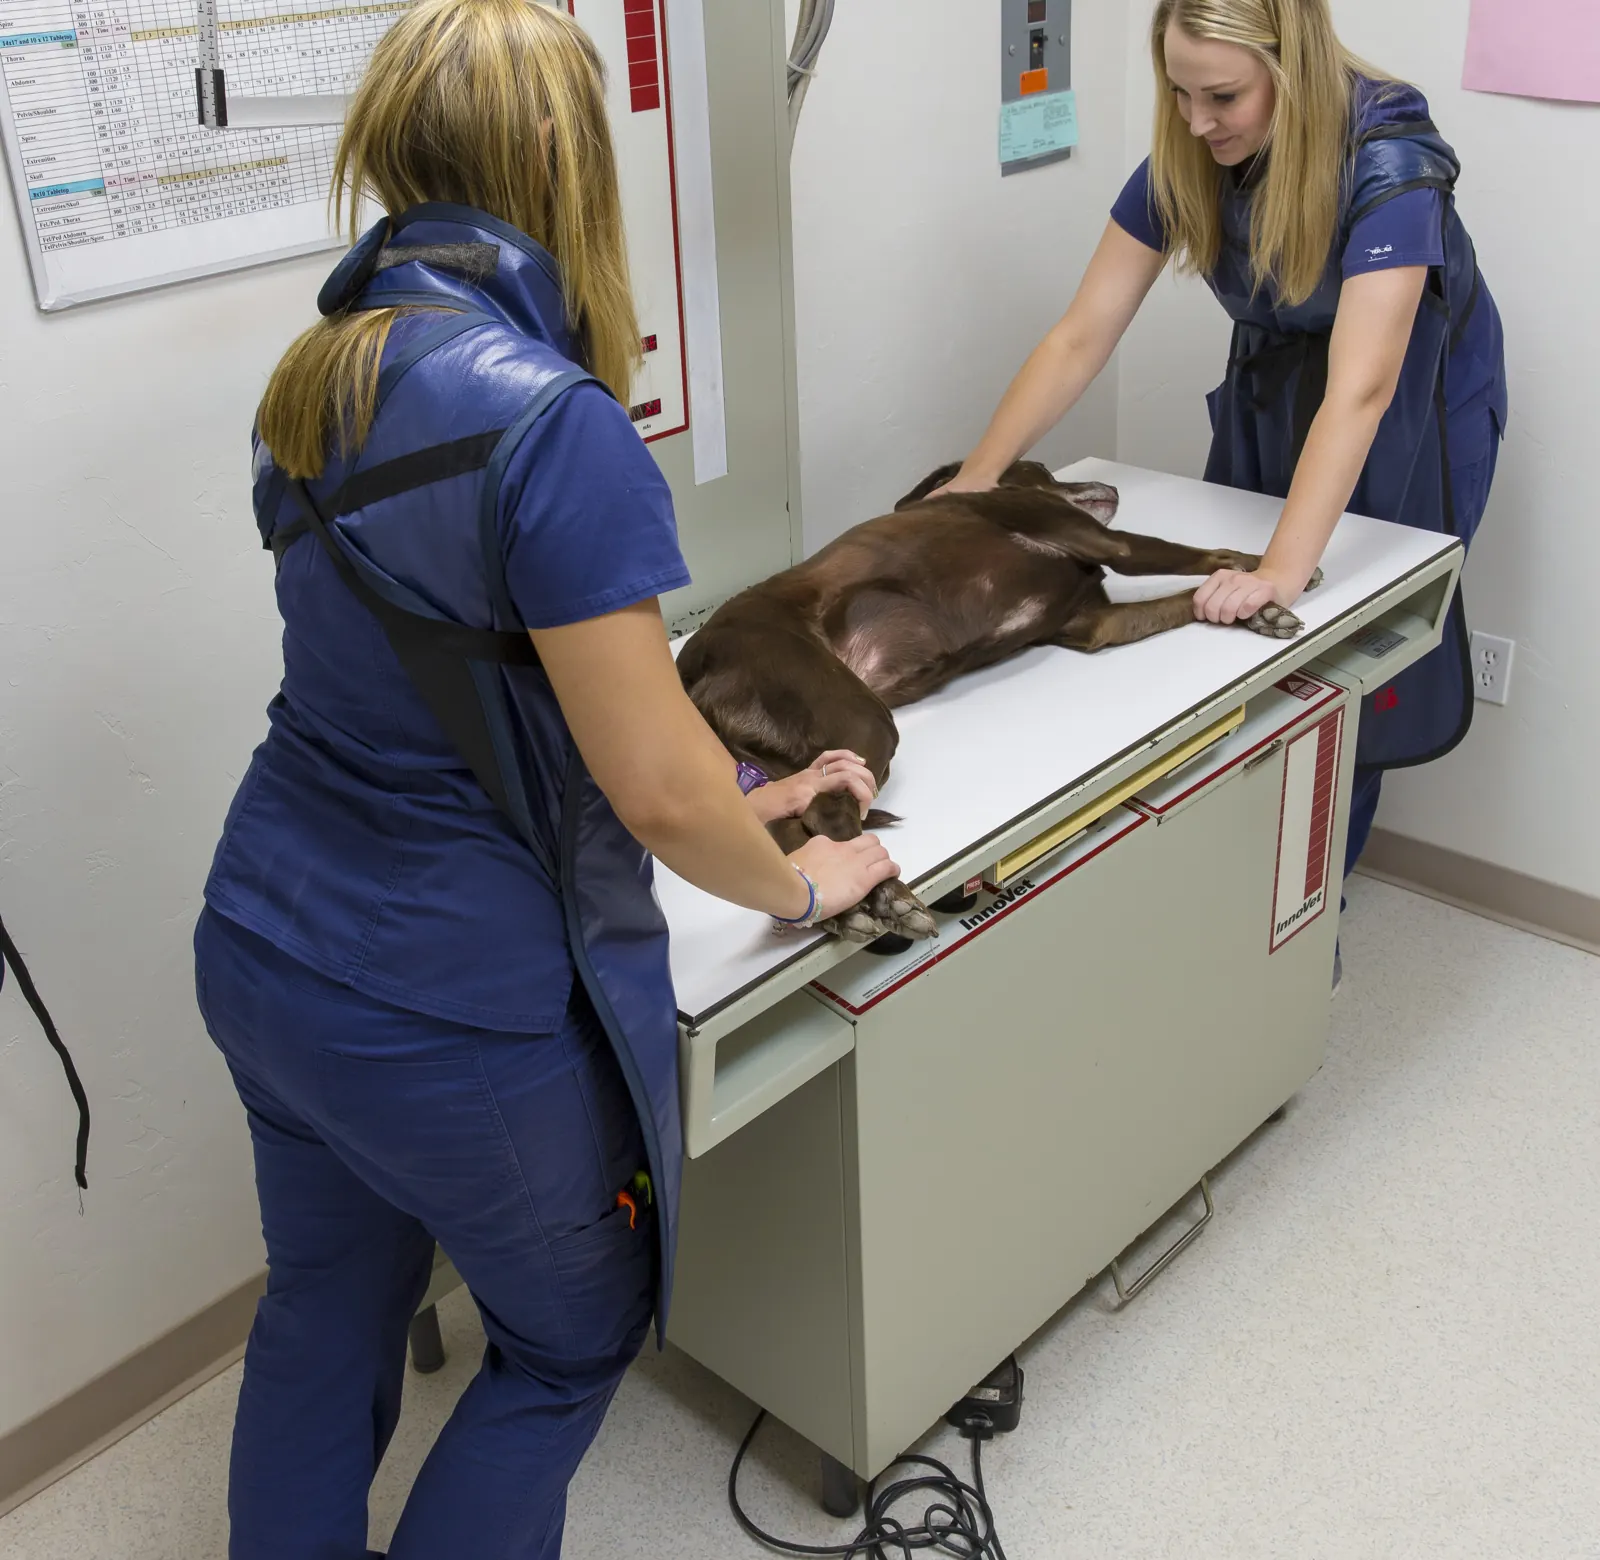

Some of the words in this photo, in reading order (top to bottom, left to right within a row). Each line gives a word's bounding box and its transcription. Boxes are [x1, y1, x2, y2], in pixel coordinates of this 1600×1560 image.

[26, 156, 56, 164] Extremities
[63, 231, 87, 239] Abdomen
[966, 880, 980, 890] PRESS
[959, 878, 1036, 931] InnoVet
[1276, 890, 1322, 936] InnoVet
